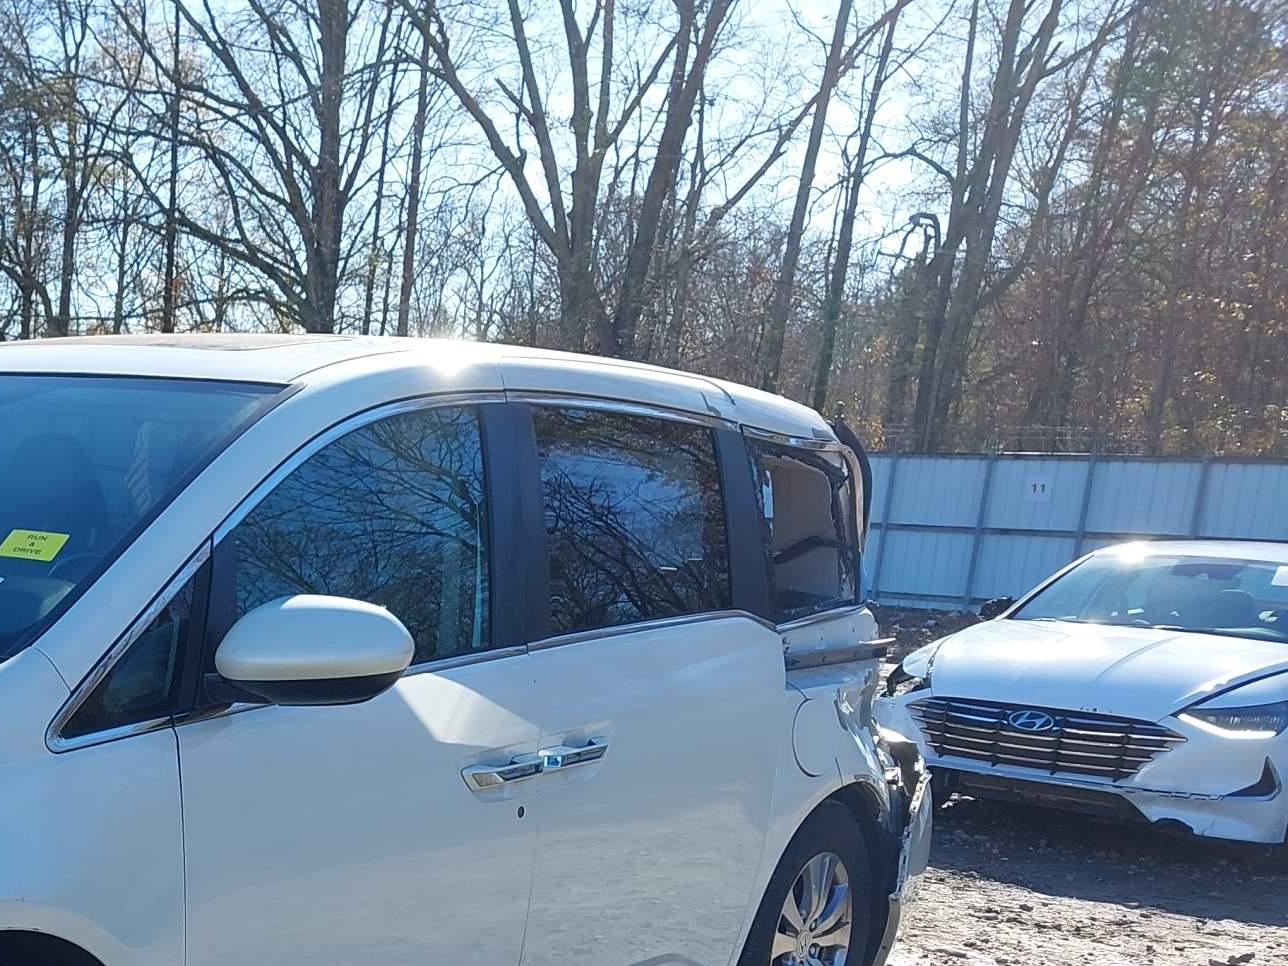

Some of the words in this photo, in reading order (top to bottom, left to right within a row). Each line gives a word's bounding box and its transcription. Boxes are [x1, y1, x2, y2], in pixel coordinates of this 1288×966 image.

[1031, 483, 1046, 493] 11
[26, 534, 49, 542] RUN
[12, 546, 43, 555] DRIVE
